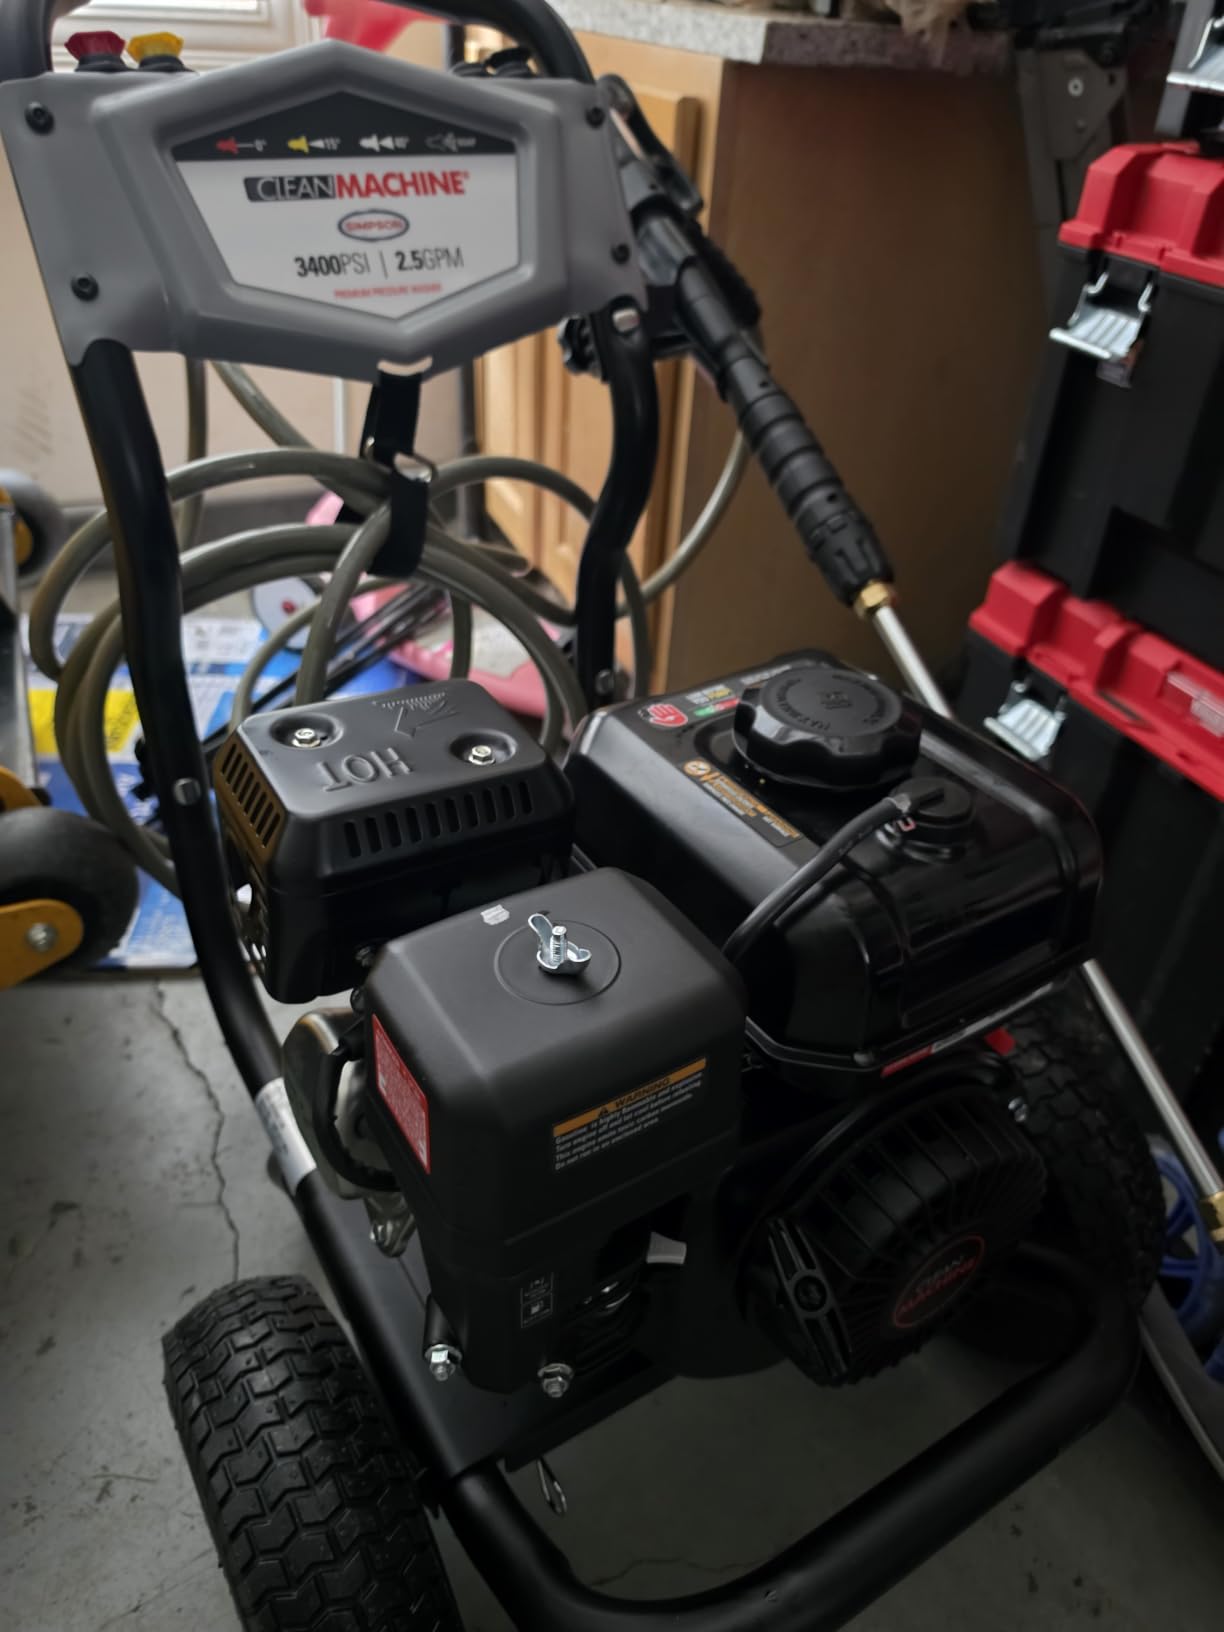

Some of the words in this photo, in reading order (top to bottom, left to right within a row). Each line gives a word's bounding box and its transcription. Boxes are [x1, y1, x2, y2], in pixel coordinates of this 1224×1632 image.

[294, 252, 370, 278] 3400PSI
[395, 247, 464, 271] 2.5GPM
[315, 748, 415, 792] HOT
[615, 1077, 669, 1108] WARNING
